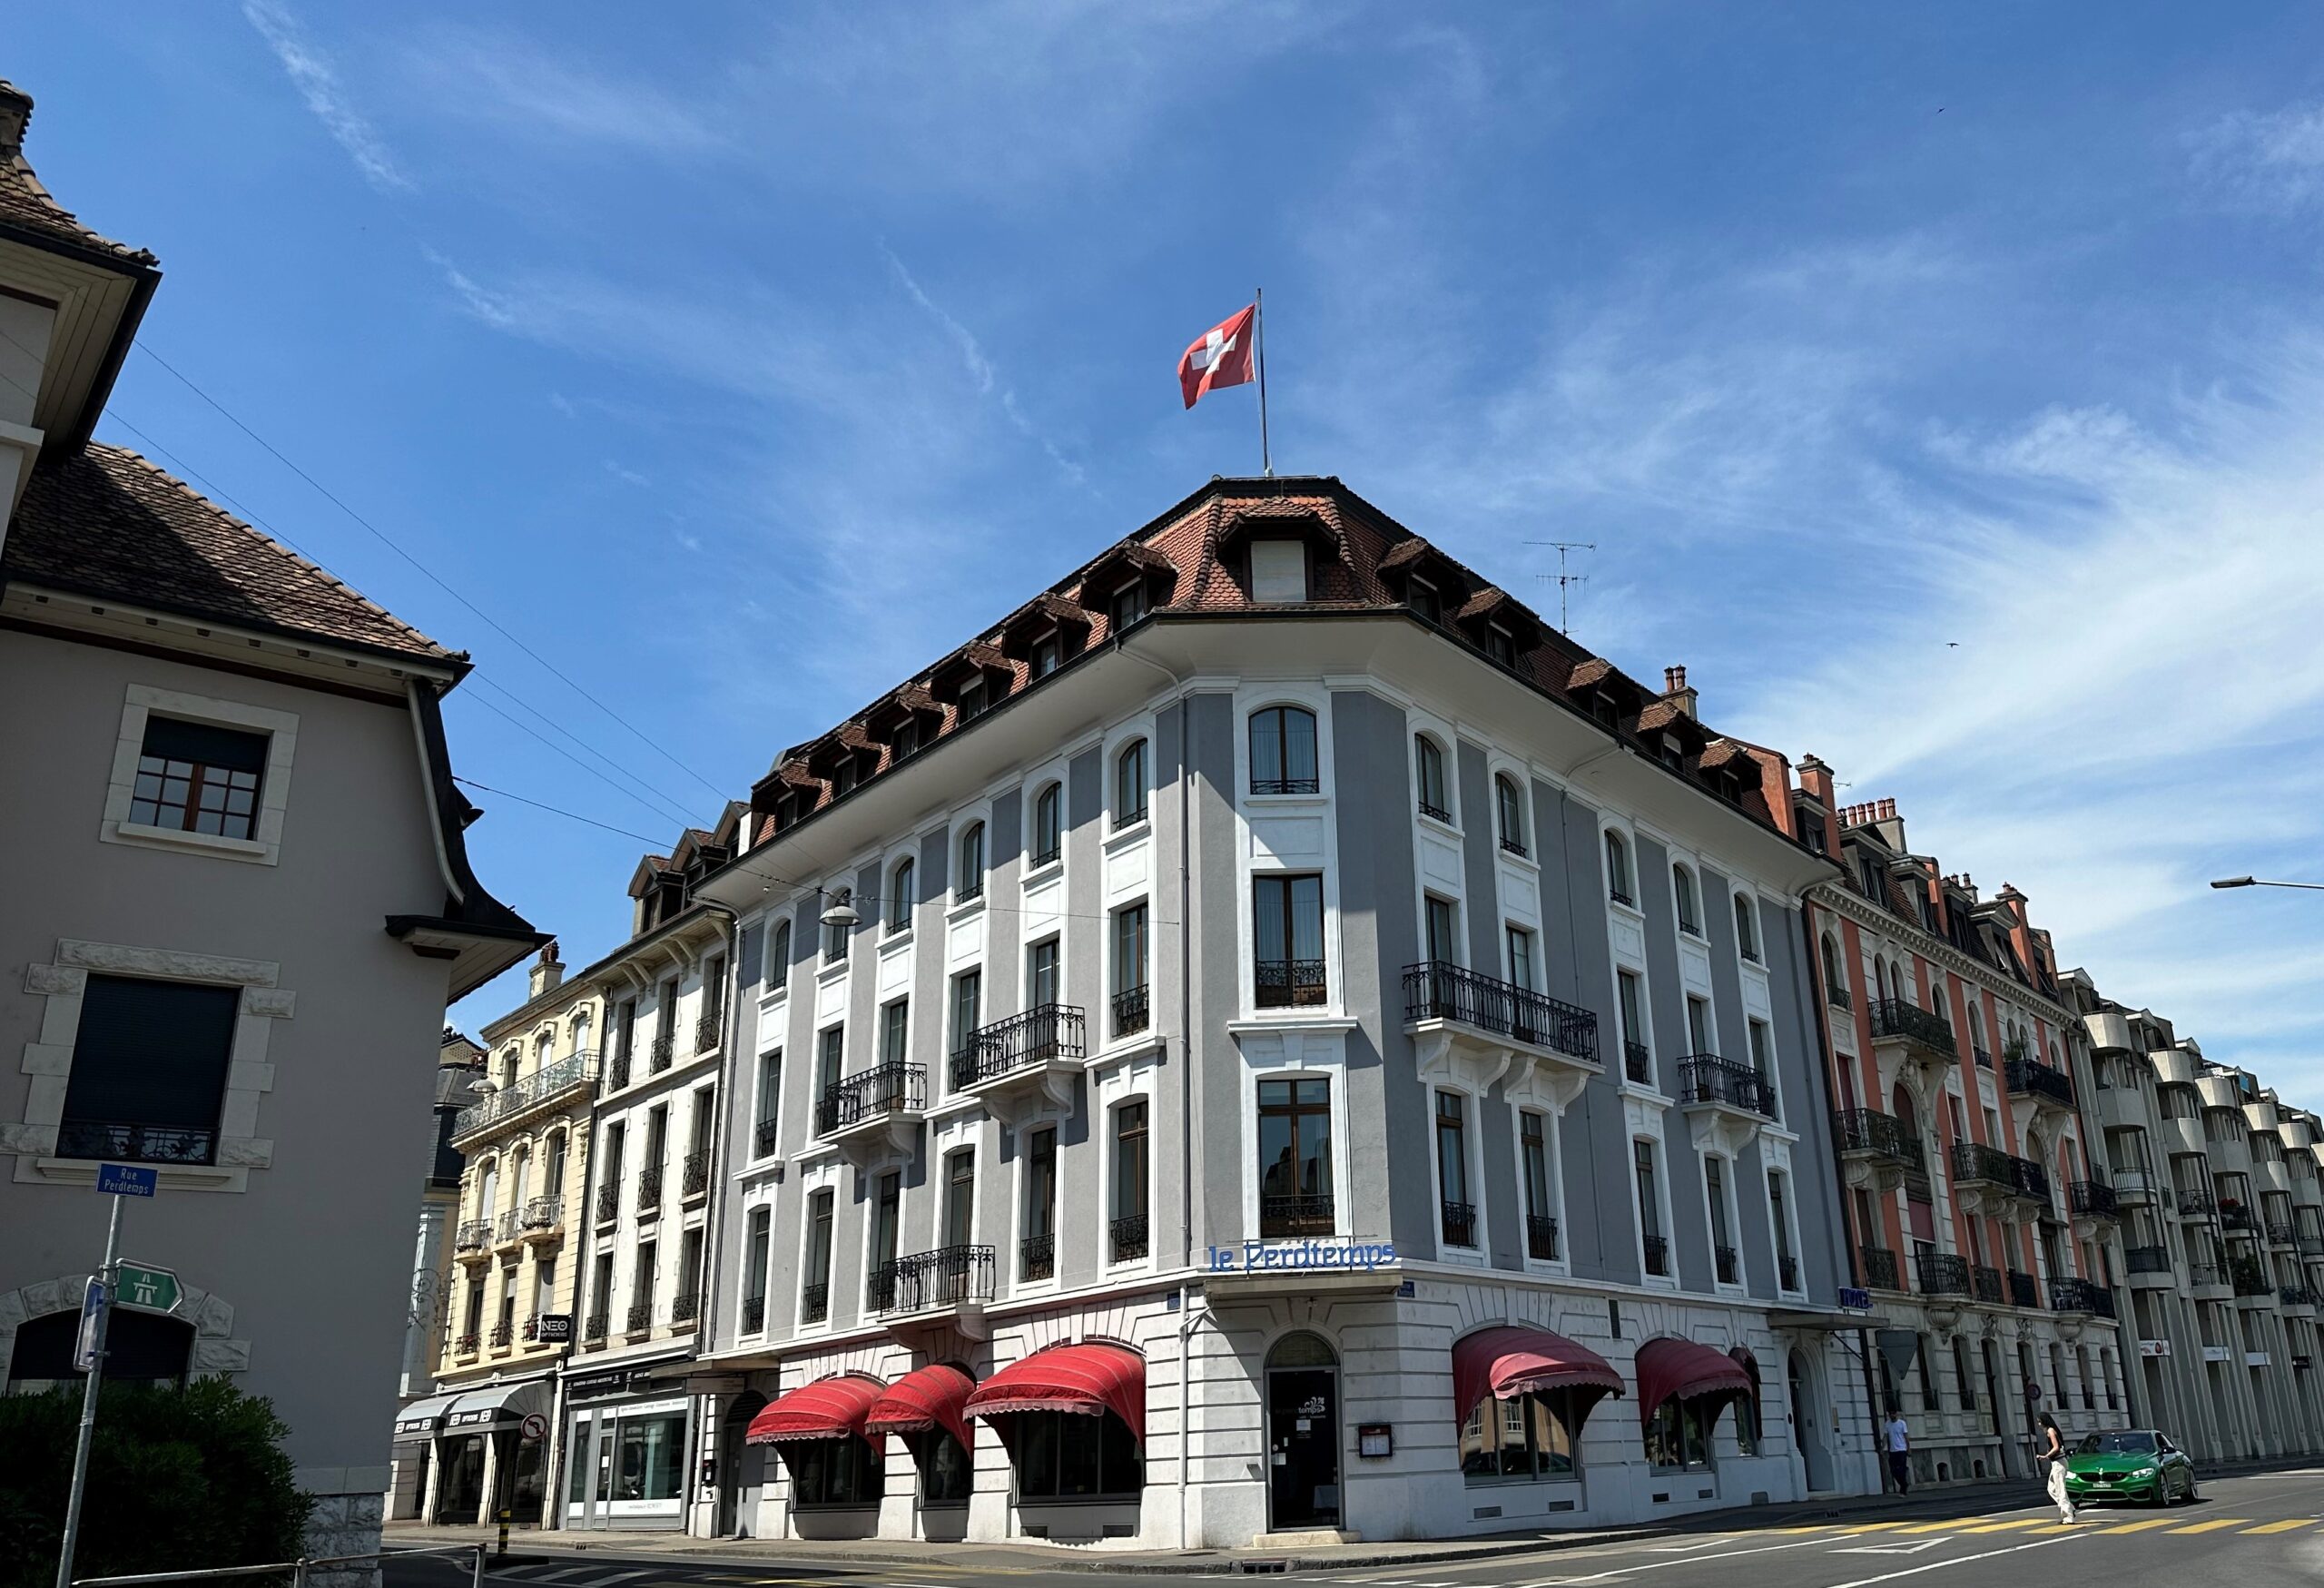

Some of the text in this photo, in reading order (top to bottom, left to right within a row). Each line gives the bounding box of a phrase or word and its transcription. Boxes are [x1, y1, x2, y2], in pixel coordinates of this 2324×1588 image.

[120, 1168, 137, 1180] Rue
[1208, 1242, 1397, 1272] le Perdtemps
[541, 1320, 568, 1331] NEO
